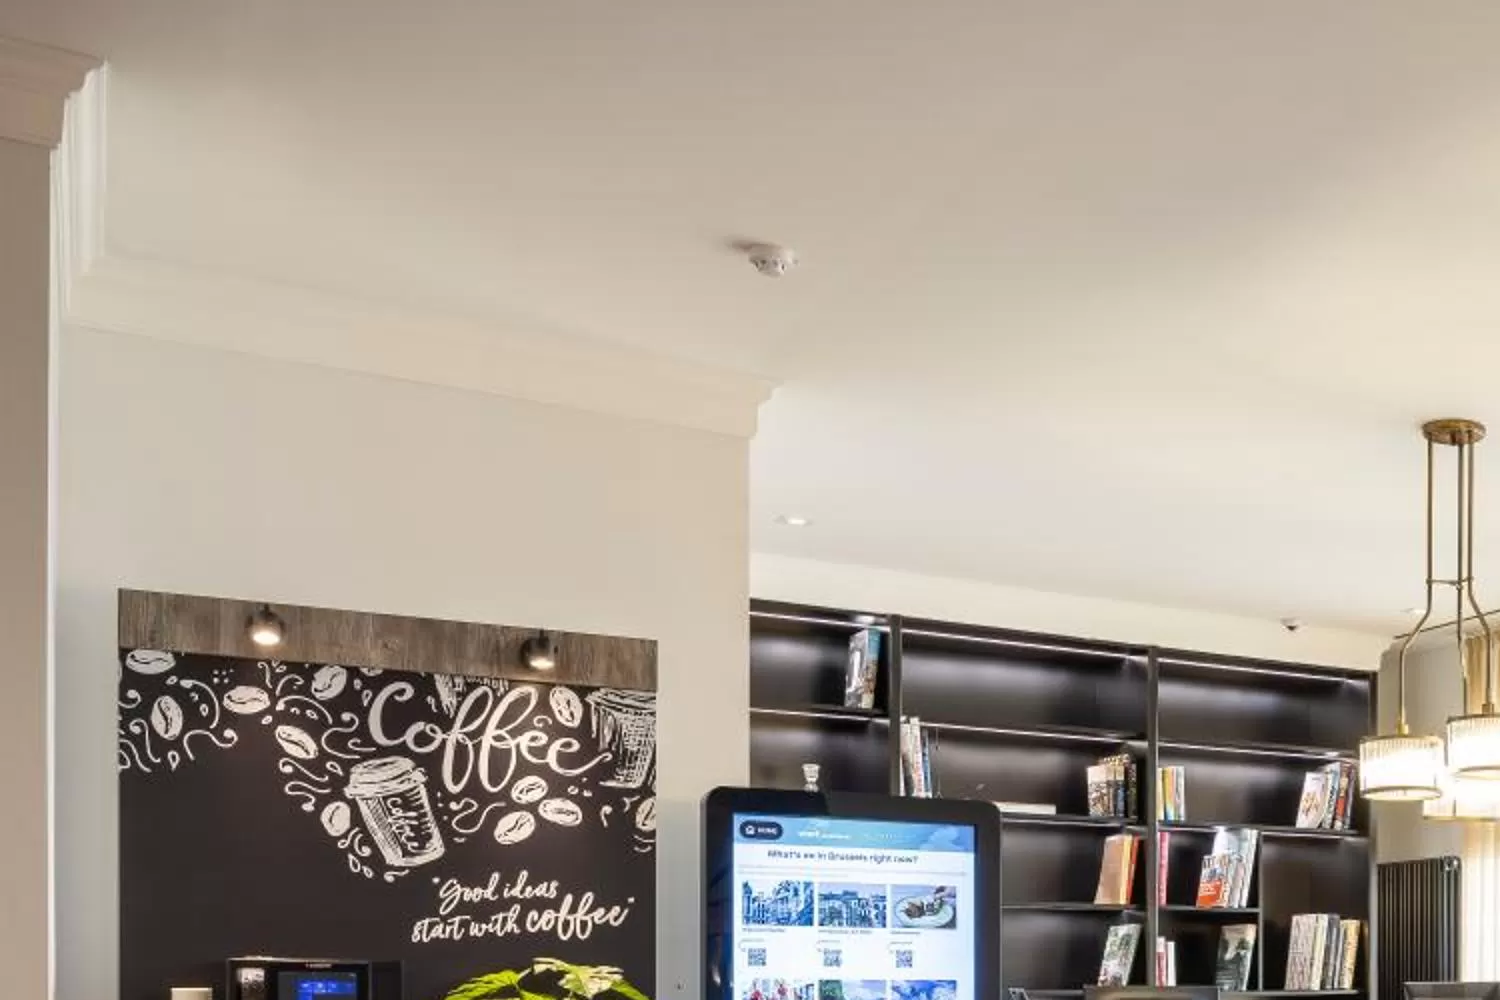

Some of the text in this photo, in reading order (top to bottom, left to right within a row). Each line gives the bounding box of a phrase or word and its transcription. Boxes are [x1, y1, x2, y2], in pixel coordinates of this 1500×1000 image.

[368, 681, 612, 794] Coffee
[503, 869, 560, 899] ideas
[411, 914, 472, 943] start
[469, 903, 521, 937] with
